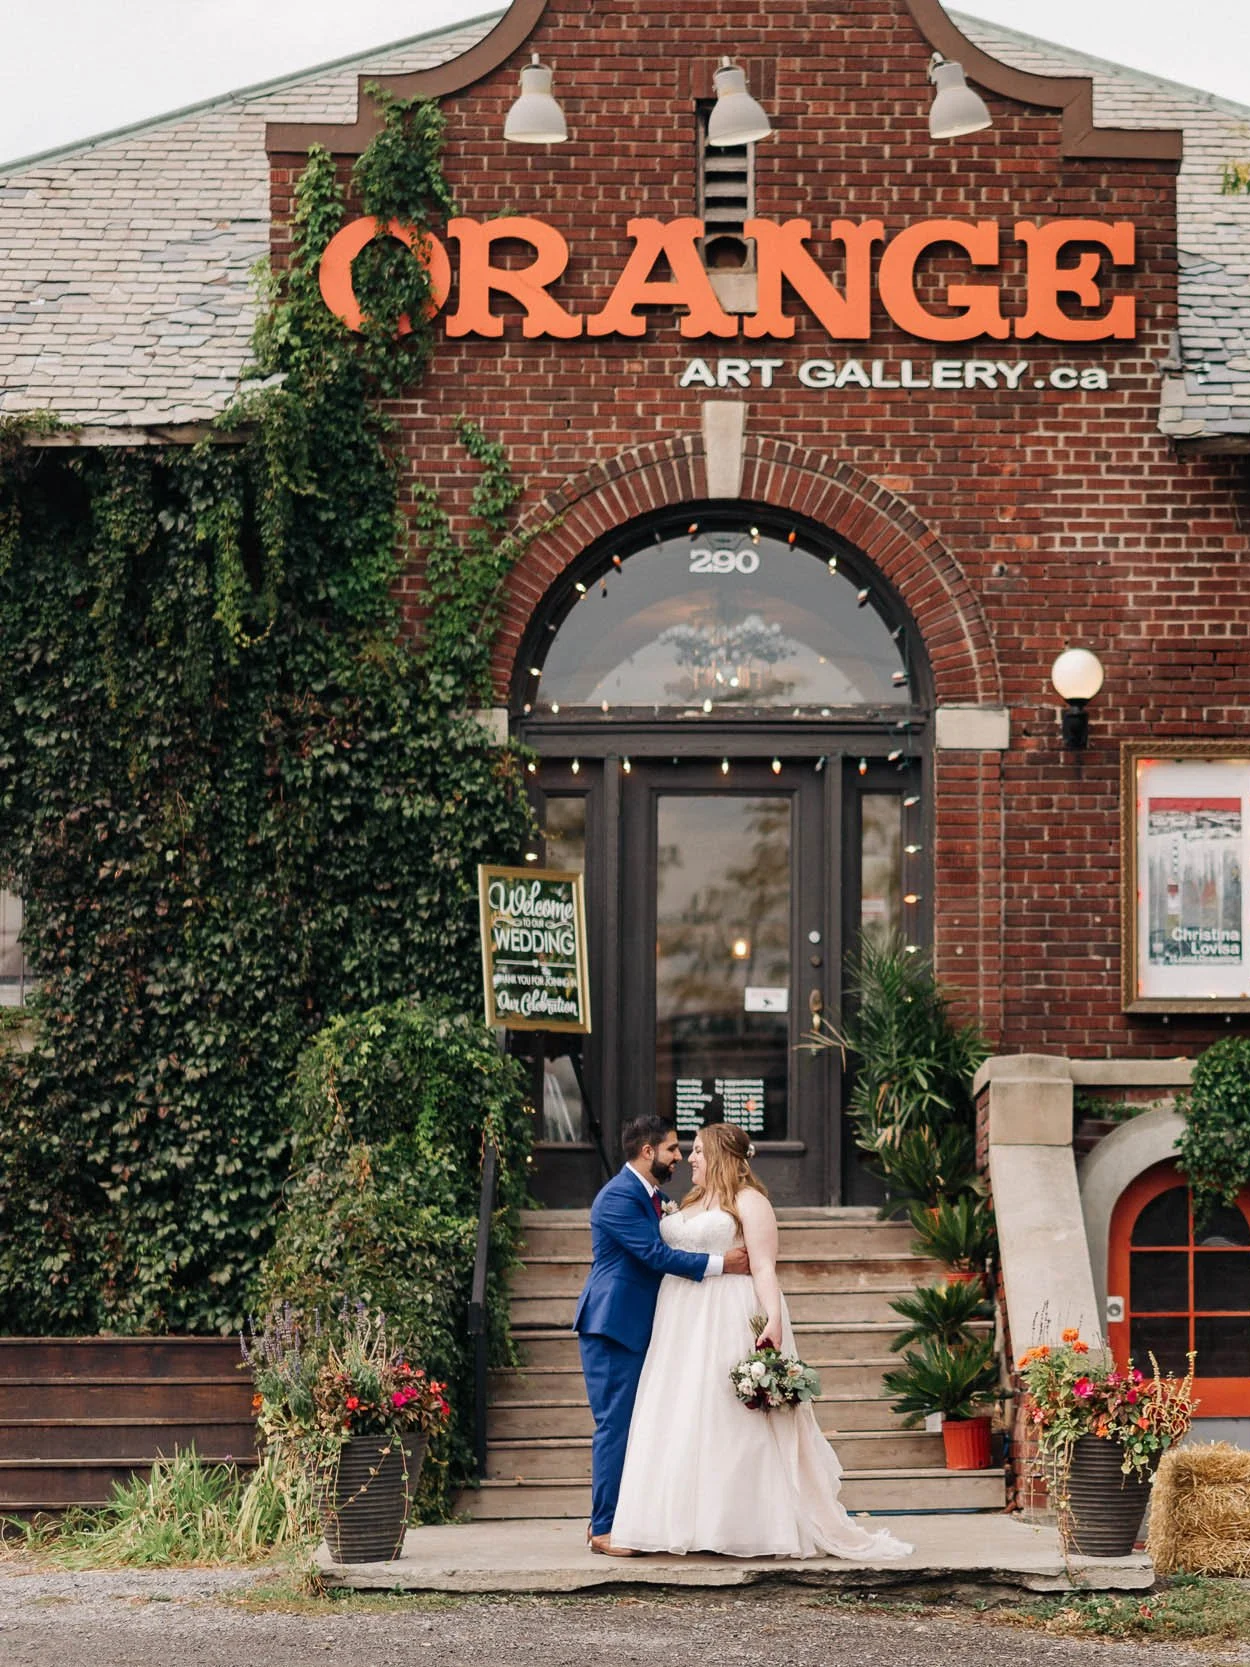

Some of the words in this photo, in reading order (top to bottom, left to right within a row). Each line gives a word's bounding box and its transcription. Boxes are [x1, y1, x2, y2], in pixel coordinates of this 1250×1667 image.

[318, 216, 1136, 341] ORANGE
[680, 358, 783, 388] ART
[689, 549, 760, 574] 290
[488, 880, 574, 919] Welcome
[494, 928, 575, 955] WEDDING
[1171, 926, 1240, 941] Christina
[1191, 941, 1240, 955] Lovisa
[517, 974, 531, 985] YOU
[497, 991, 520, 1013] Our
[521, 989, 578, 1017] Celebration
